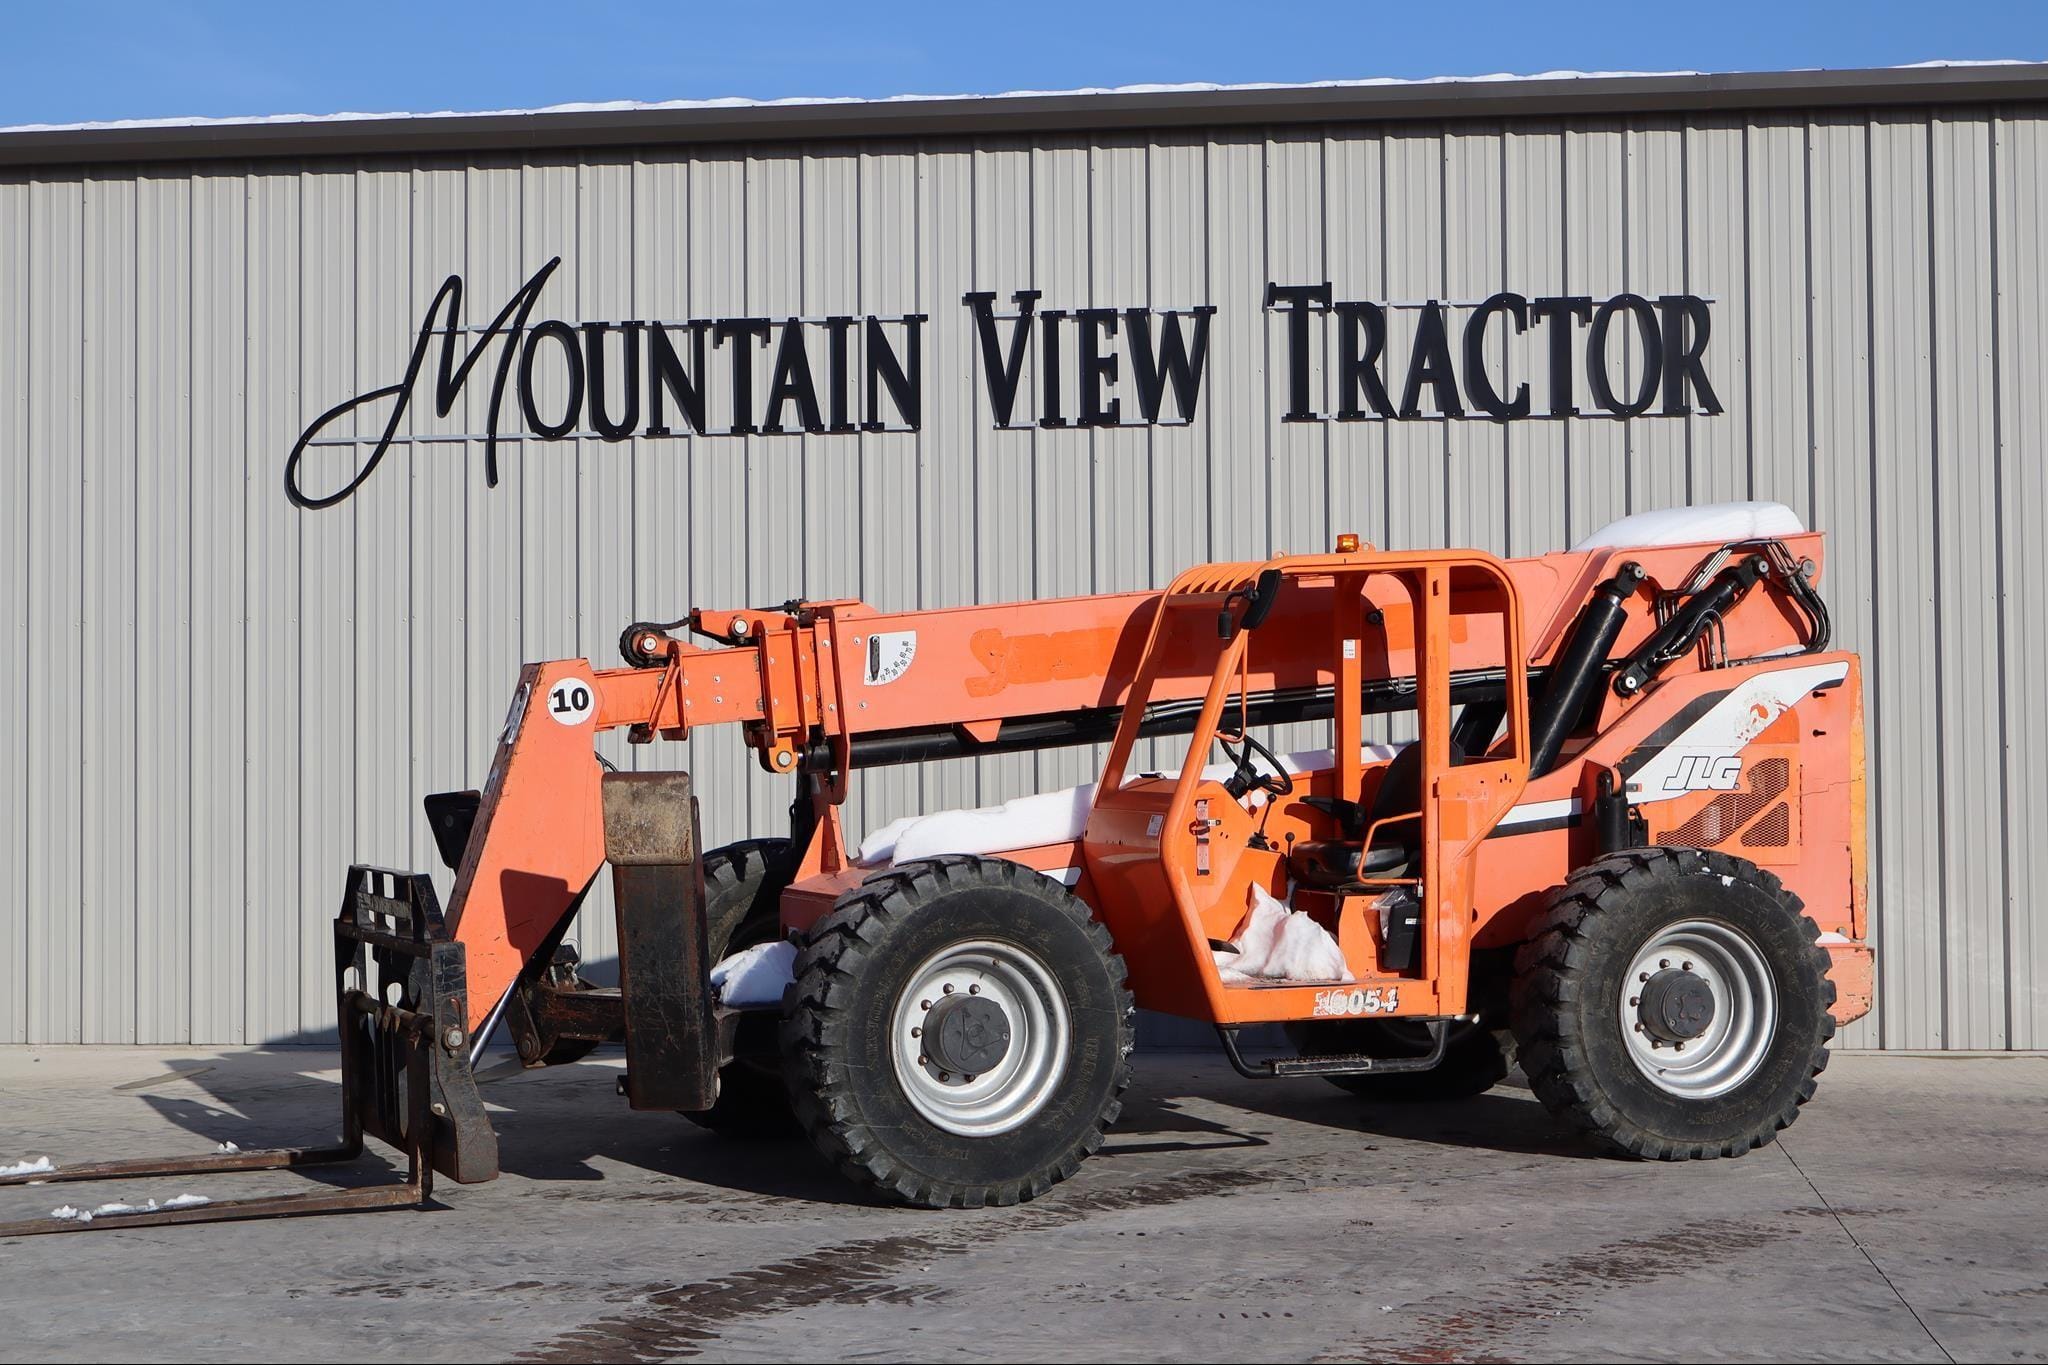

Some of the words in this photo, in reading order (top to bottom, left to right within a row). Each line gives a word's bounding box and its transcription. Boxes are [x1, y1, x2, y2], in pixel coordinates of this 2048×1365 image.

[284, 256, 929, 510] MOUNTAIN
[964, 289, 1217, 428] VIEW
[1267, 281, 1725, 422] TRACTOR
[553, 687, 589, 712] 10
[1662, 756, 1743, 790] JLG
